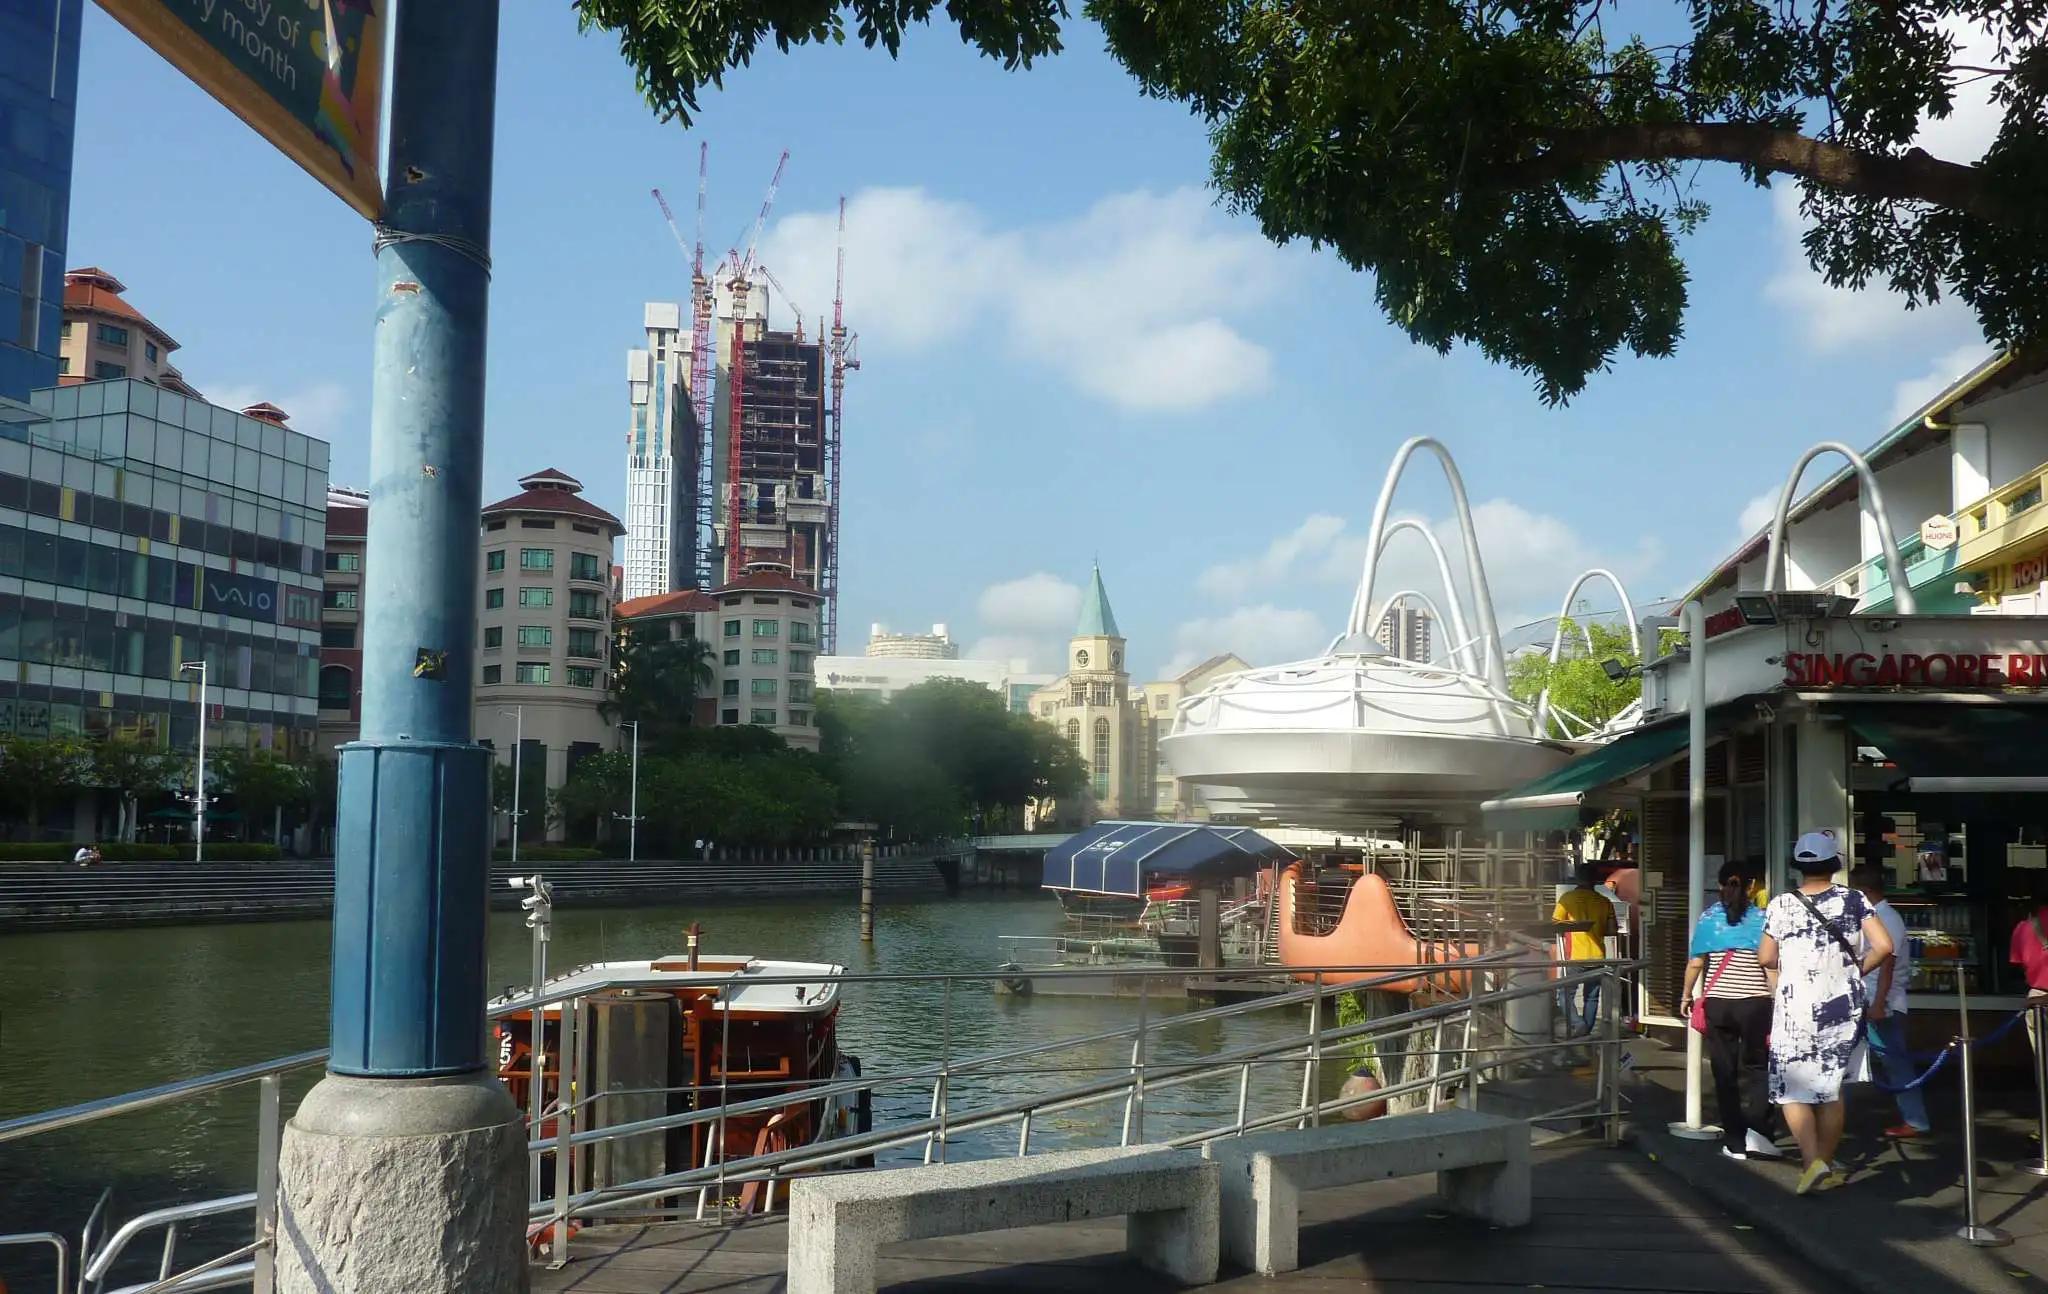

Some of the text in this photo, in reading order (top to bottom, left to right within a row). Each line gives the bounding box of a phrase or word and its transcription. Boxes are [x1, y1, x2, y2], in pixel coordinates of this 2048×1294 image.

[278, 15, 301, 48] of
[221, 8, 296, 91] month
[209, 583, 271, 610] VAIO
[1784, 652, 2002, 687] SINGAPORE
